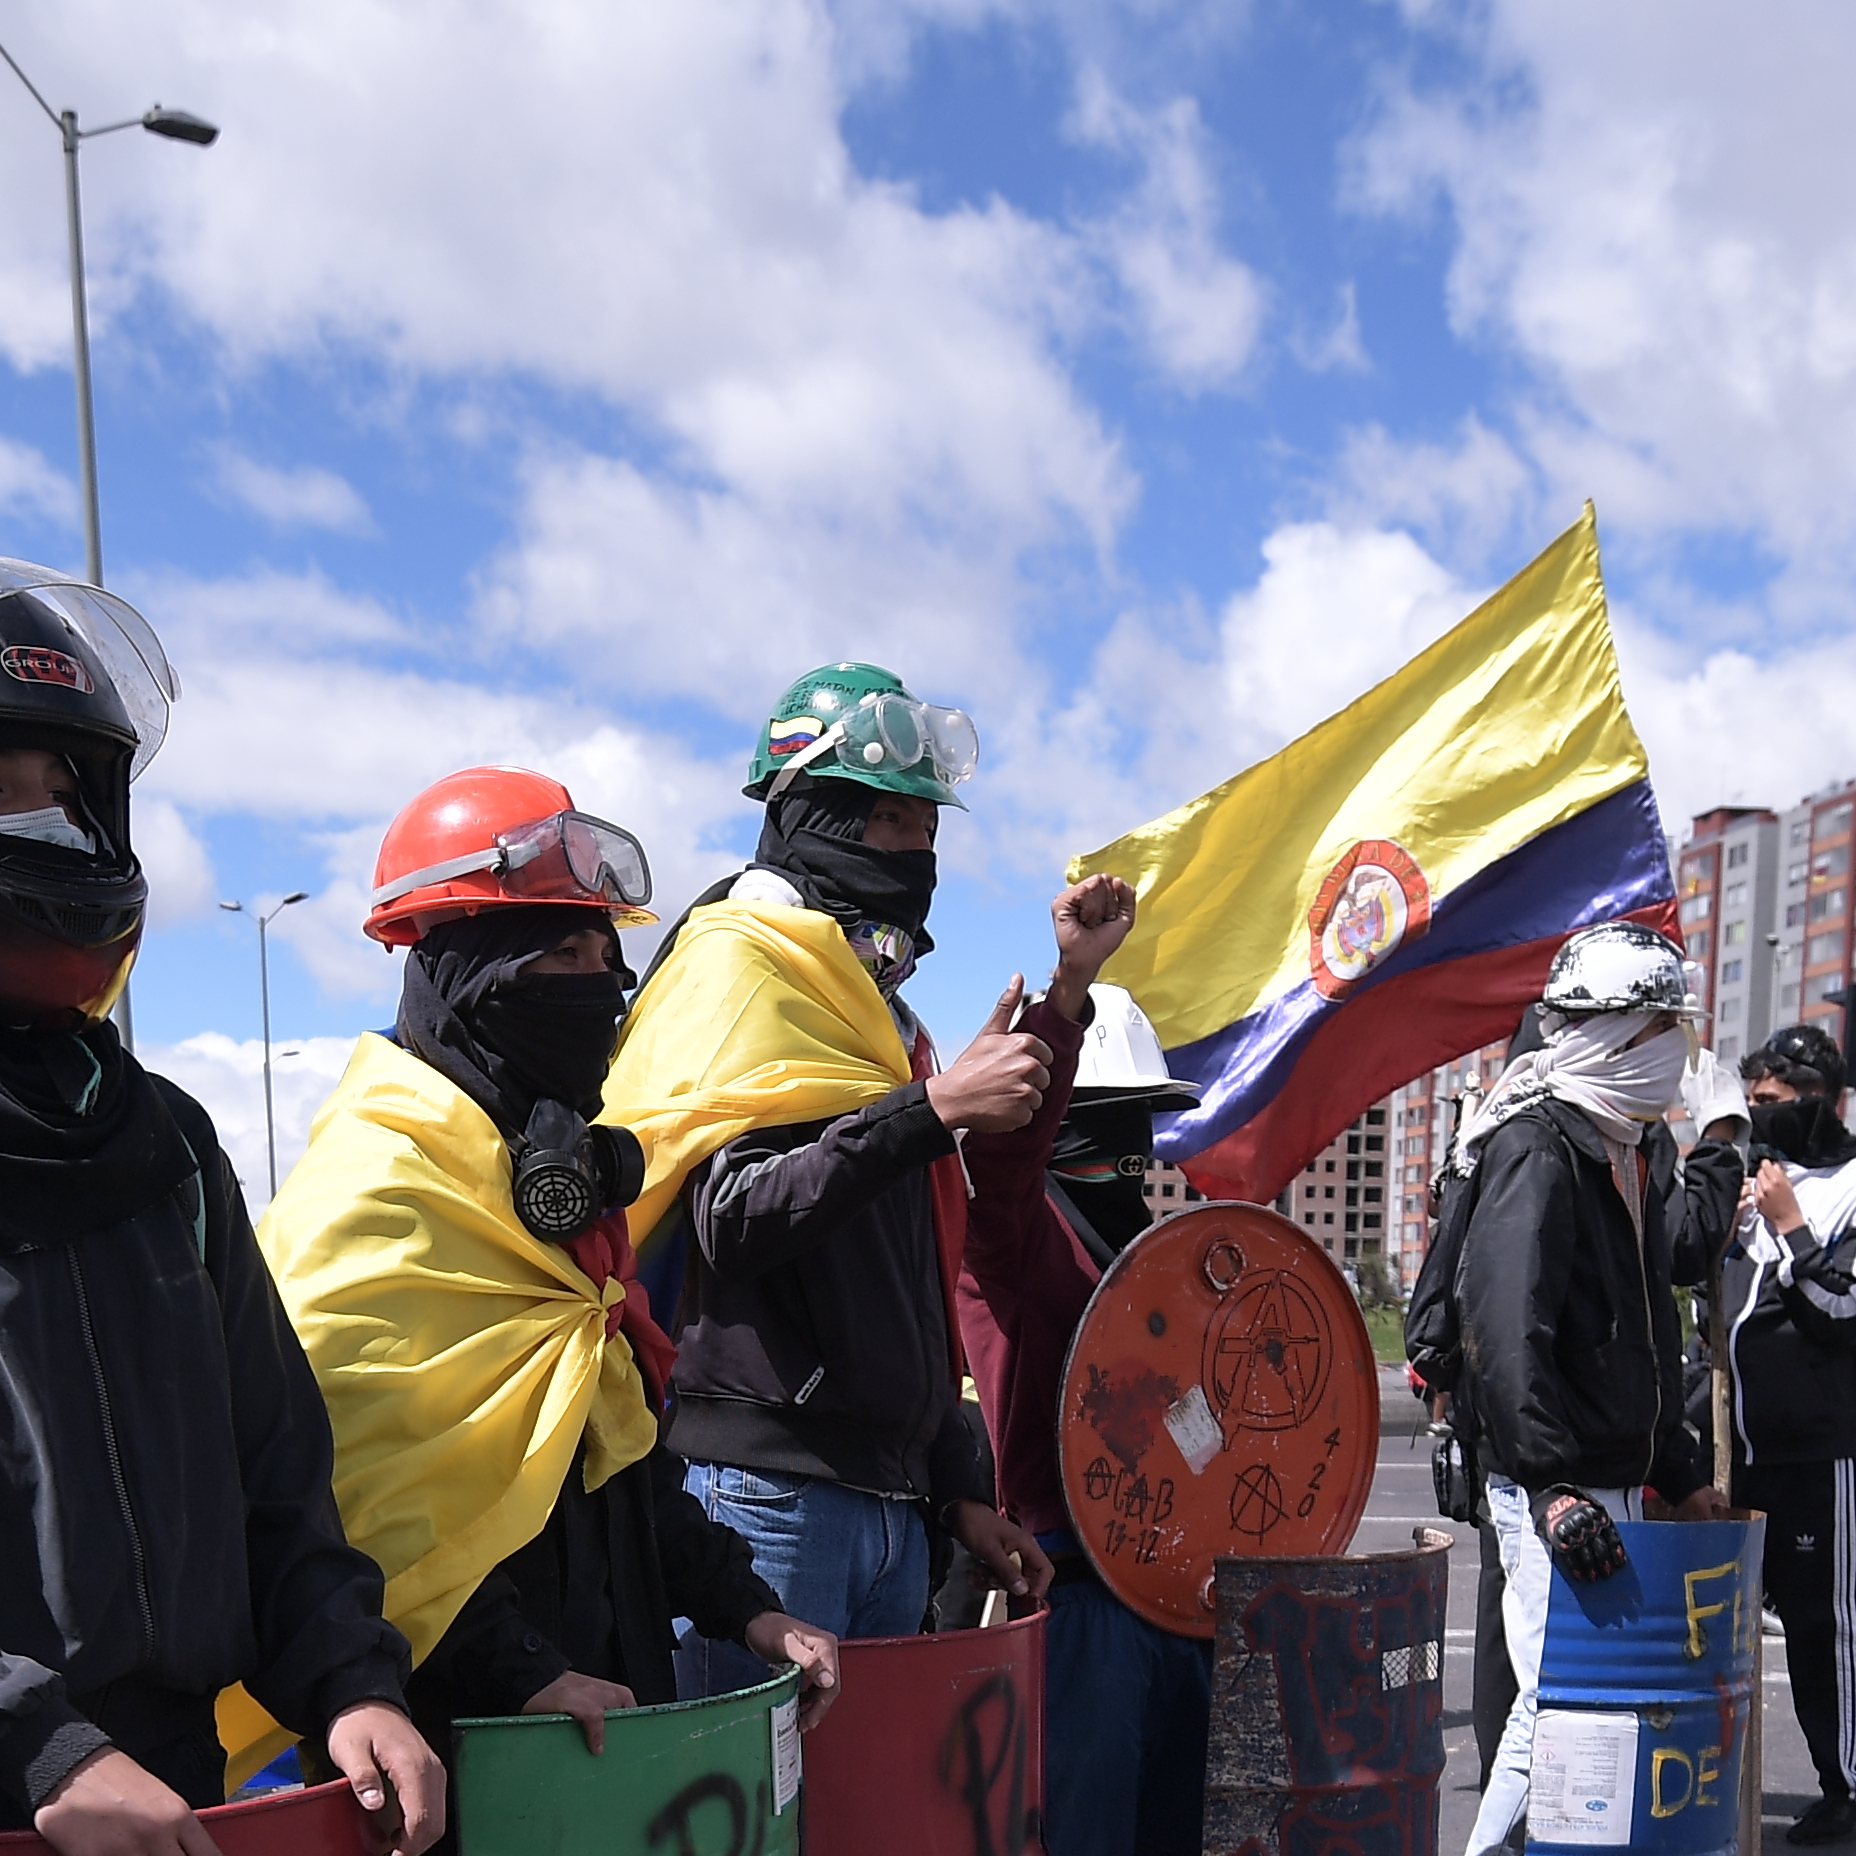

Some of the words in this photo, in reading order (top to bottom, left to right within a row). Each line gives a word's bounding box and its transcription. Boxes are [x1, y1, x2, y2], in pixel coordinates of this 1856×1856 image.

[1388, 850, 1418, 887] DE
[1546, 1495, 1578, 1520] KTM
[1651, 1746, 1722, 1818] DE
